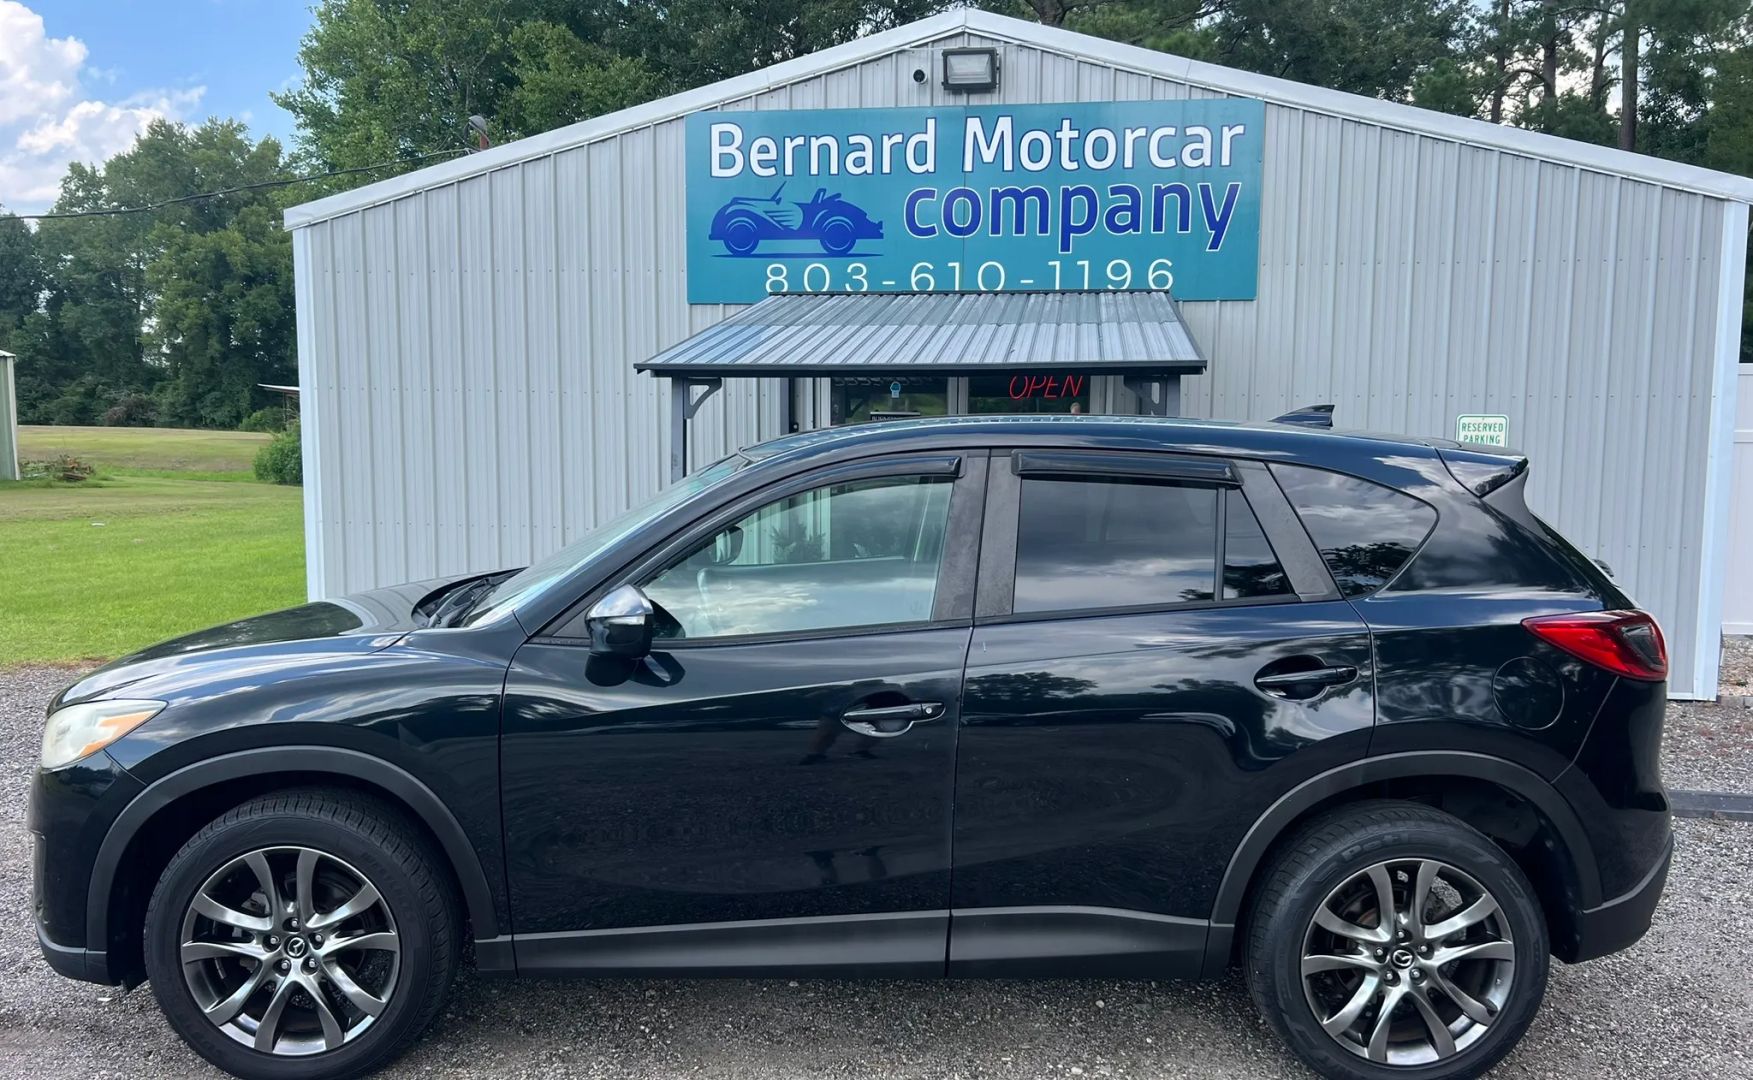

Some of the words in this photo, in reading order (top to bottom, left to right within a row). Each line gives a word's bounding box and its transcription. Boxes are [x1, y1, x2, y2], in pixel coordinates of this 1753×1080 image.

[708, 117, 937, 178] Bernard
[962, 115, 1246, 173] Motorcar
[903, 180, 1242, 254] company
[765, 258, 1174, 293] 803-610-1196
[1009, 375, 1084, 400] OPEN
[1461, 423, 1504, 432] RESERVED
[1463, 435, 1500, 444] PARKING
